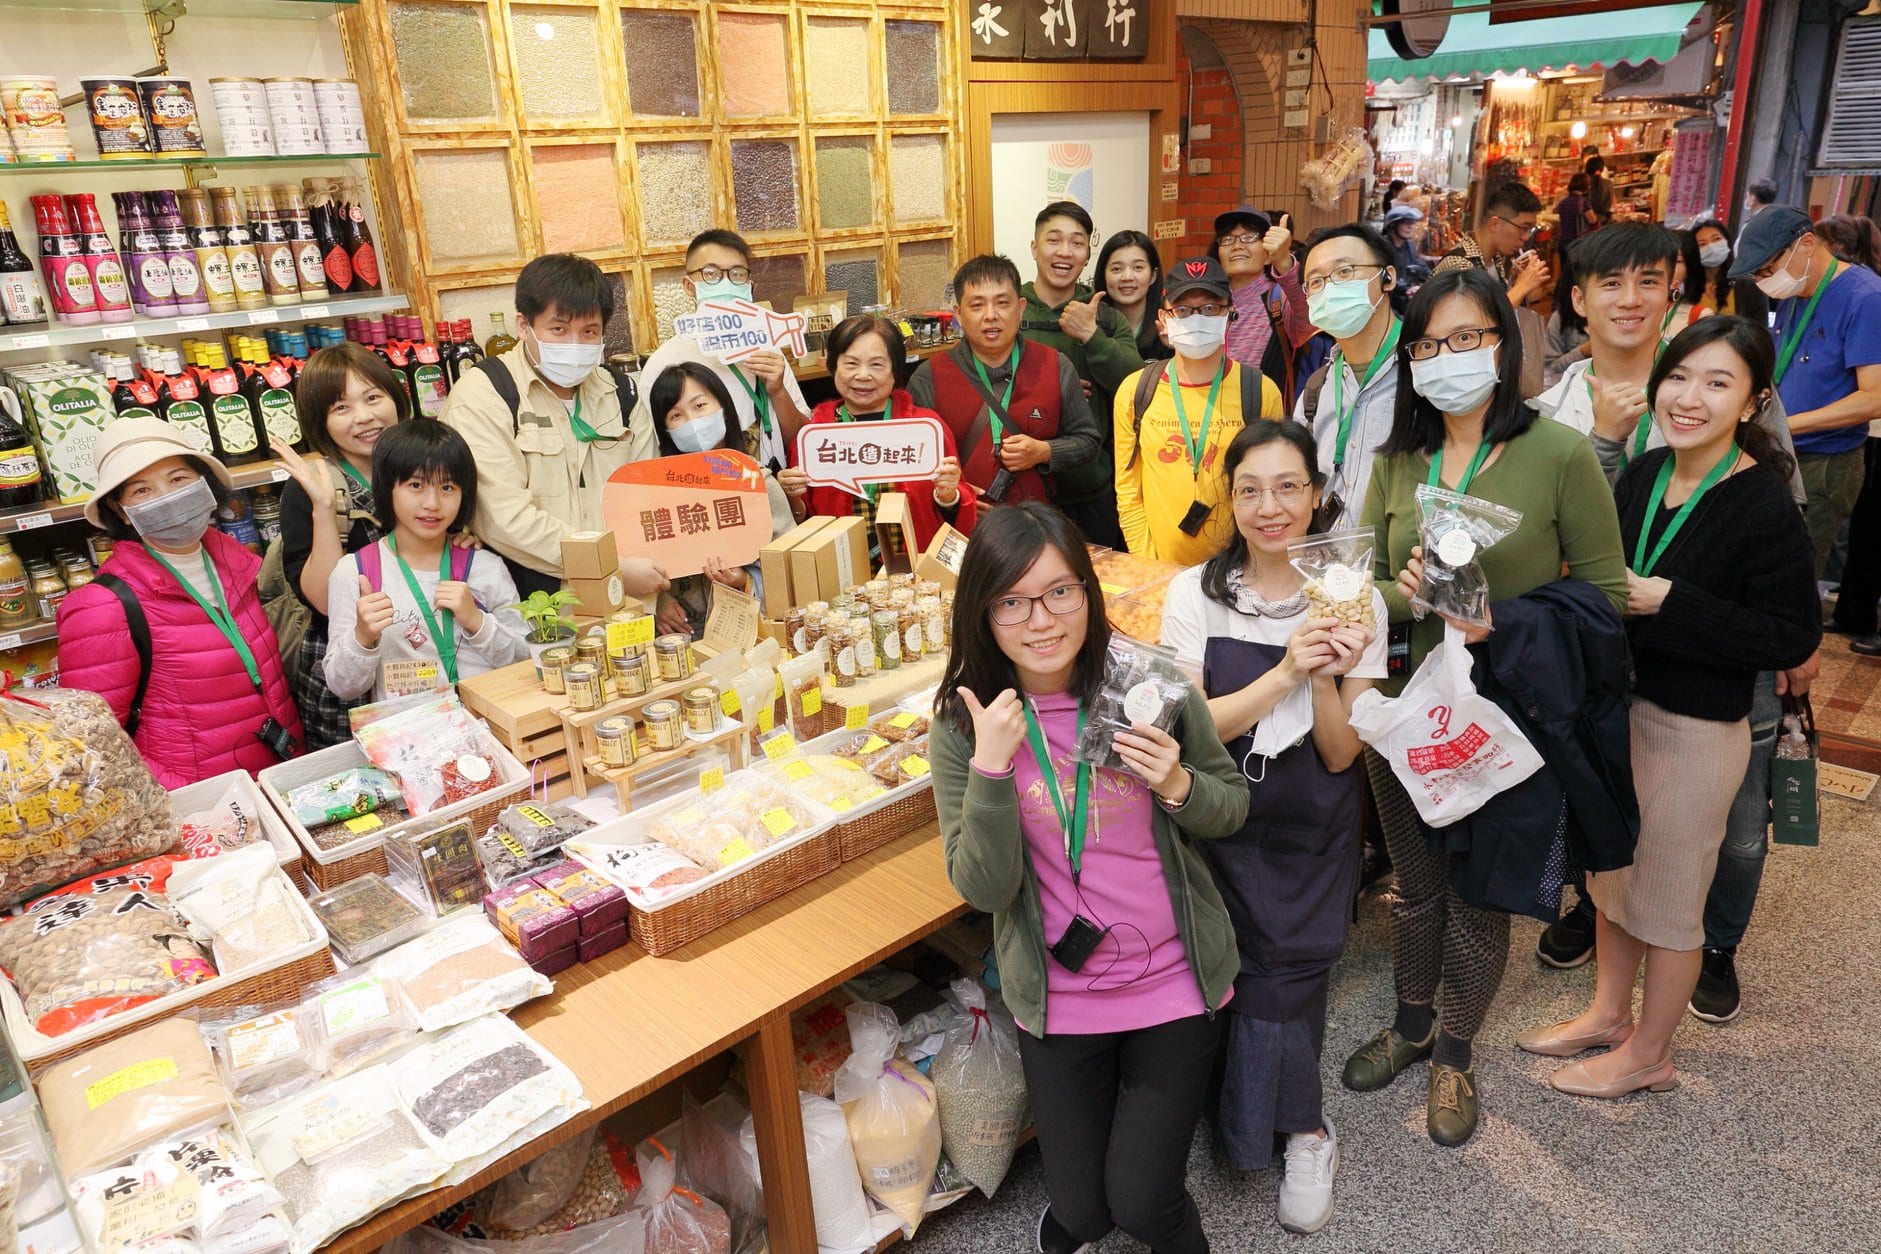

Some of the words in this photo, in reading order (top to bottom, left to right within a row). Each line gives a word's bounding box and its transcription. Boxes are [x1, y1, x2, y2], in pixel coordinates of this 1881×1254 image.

[52, 400, 96, 412] OLITALIA
[263, 397, 290, 407] OLITALIA
[217, 403, 245, 412] OLITALIA
[171, 410, 201, 420] OLITALIA
[73, 435, 97, 445] OLIO
[640, 496, 746, 542] 體驗團
